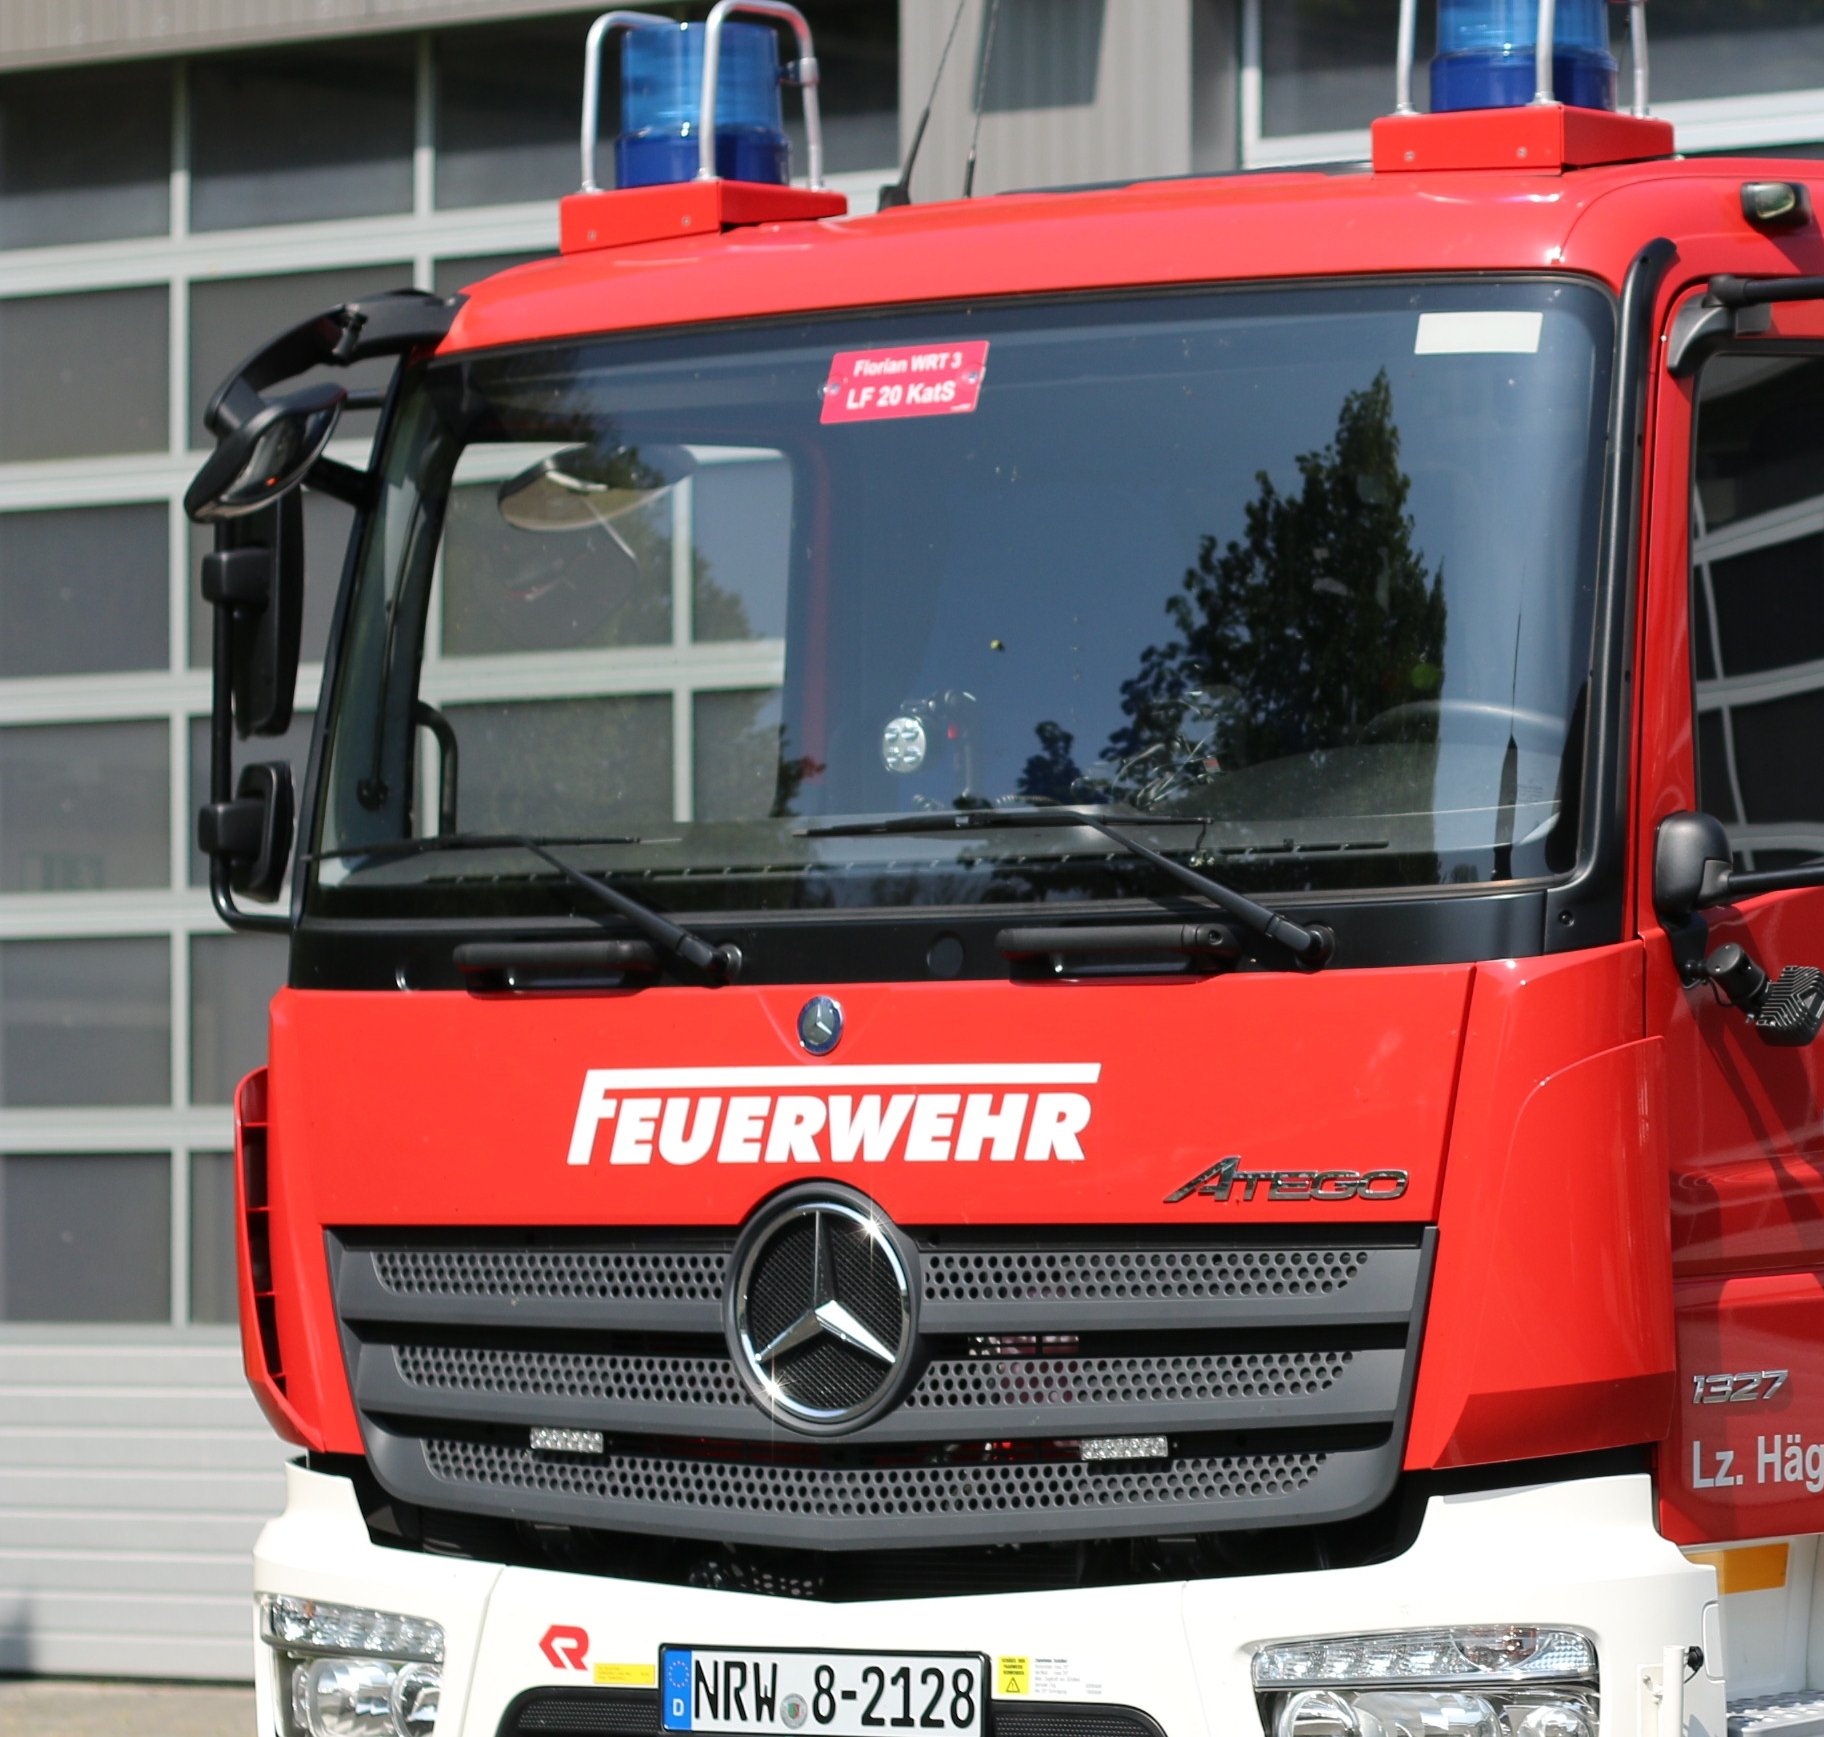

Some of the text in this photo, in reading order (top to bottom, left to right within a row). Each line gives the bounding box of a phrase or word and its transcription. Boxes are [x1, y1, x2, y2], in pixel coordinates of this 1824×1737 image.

[853, 352, 962, 377] Florian WRT 3
[846, 380, 957, 410] LF 20 KatS
[566, 1063, 1102, 1166] FEUERWEHR
[1692, 1369, 1789, 1404] 1327
[1692, 1440, 1744, 1489] Lz.
[672, 1697, 685, 1718] D
[694, 1659, 778, 1722] NRW
[812, 1664, 976, 1729] 8-2128
